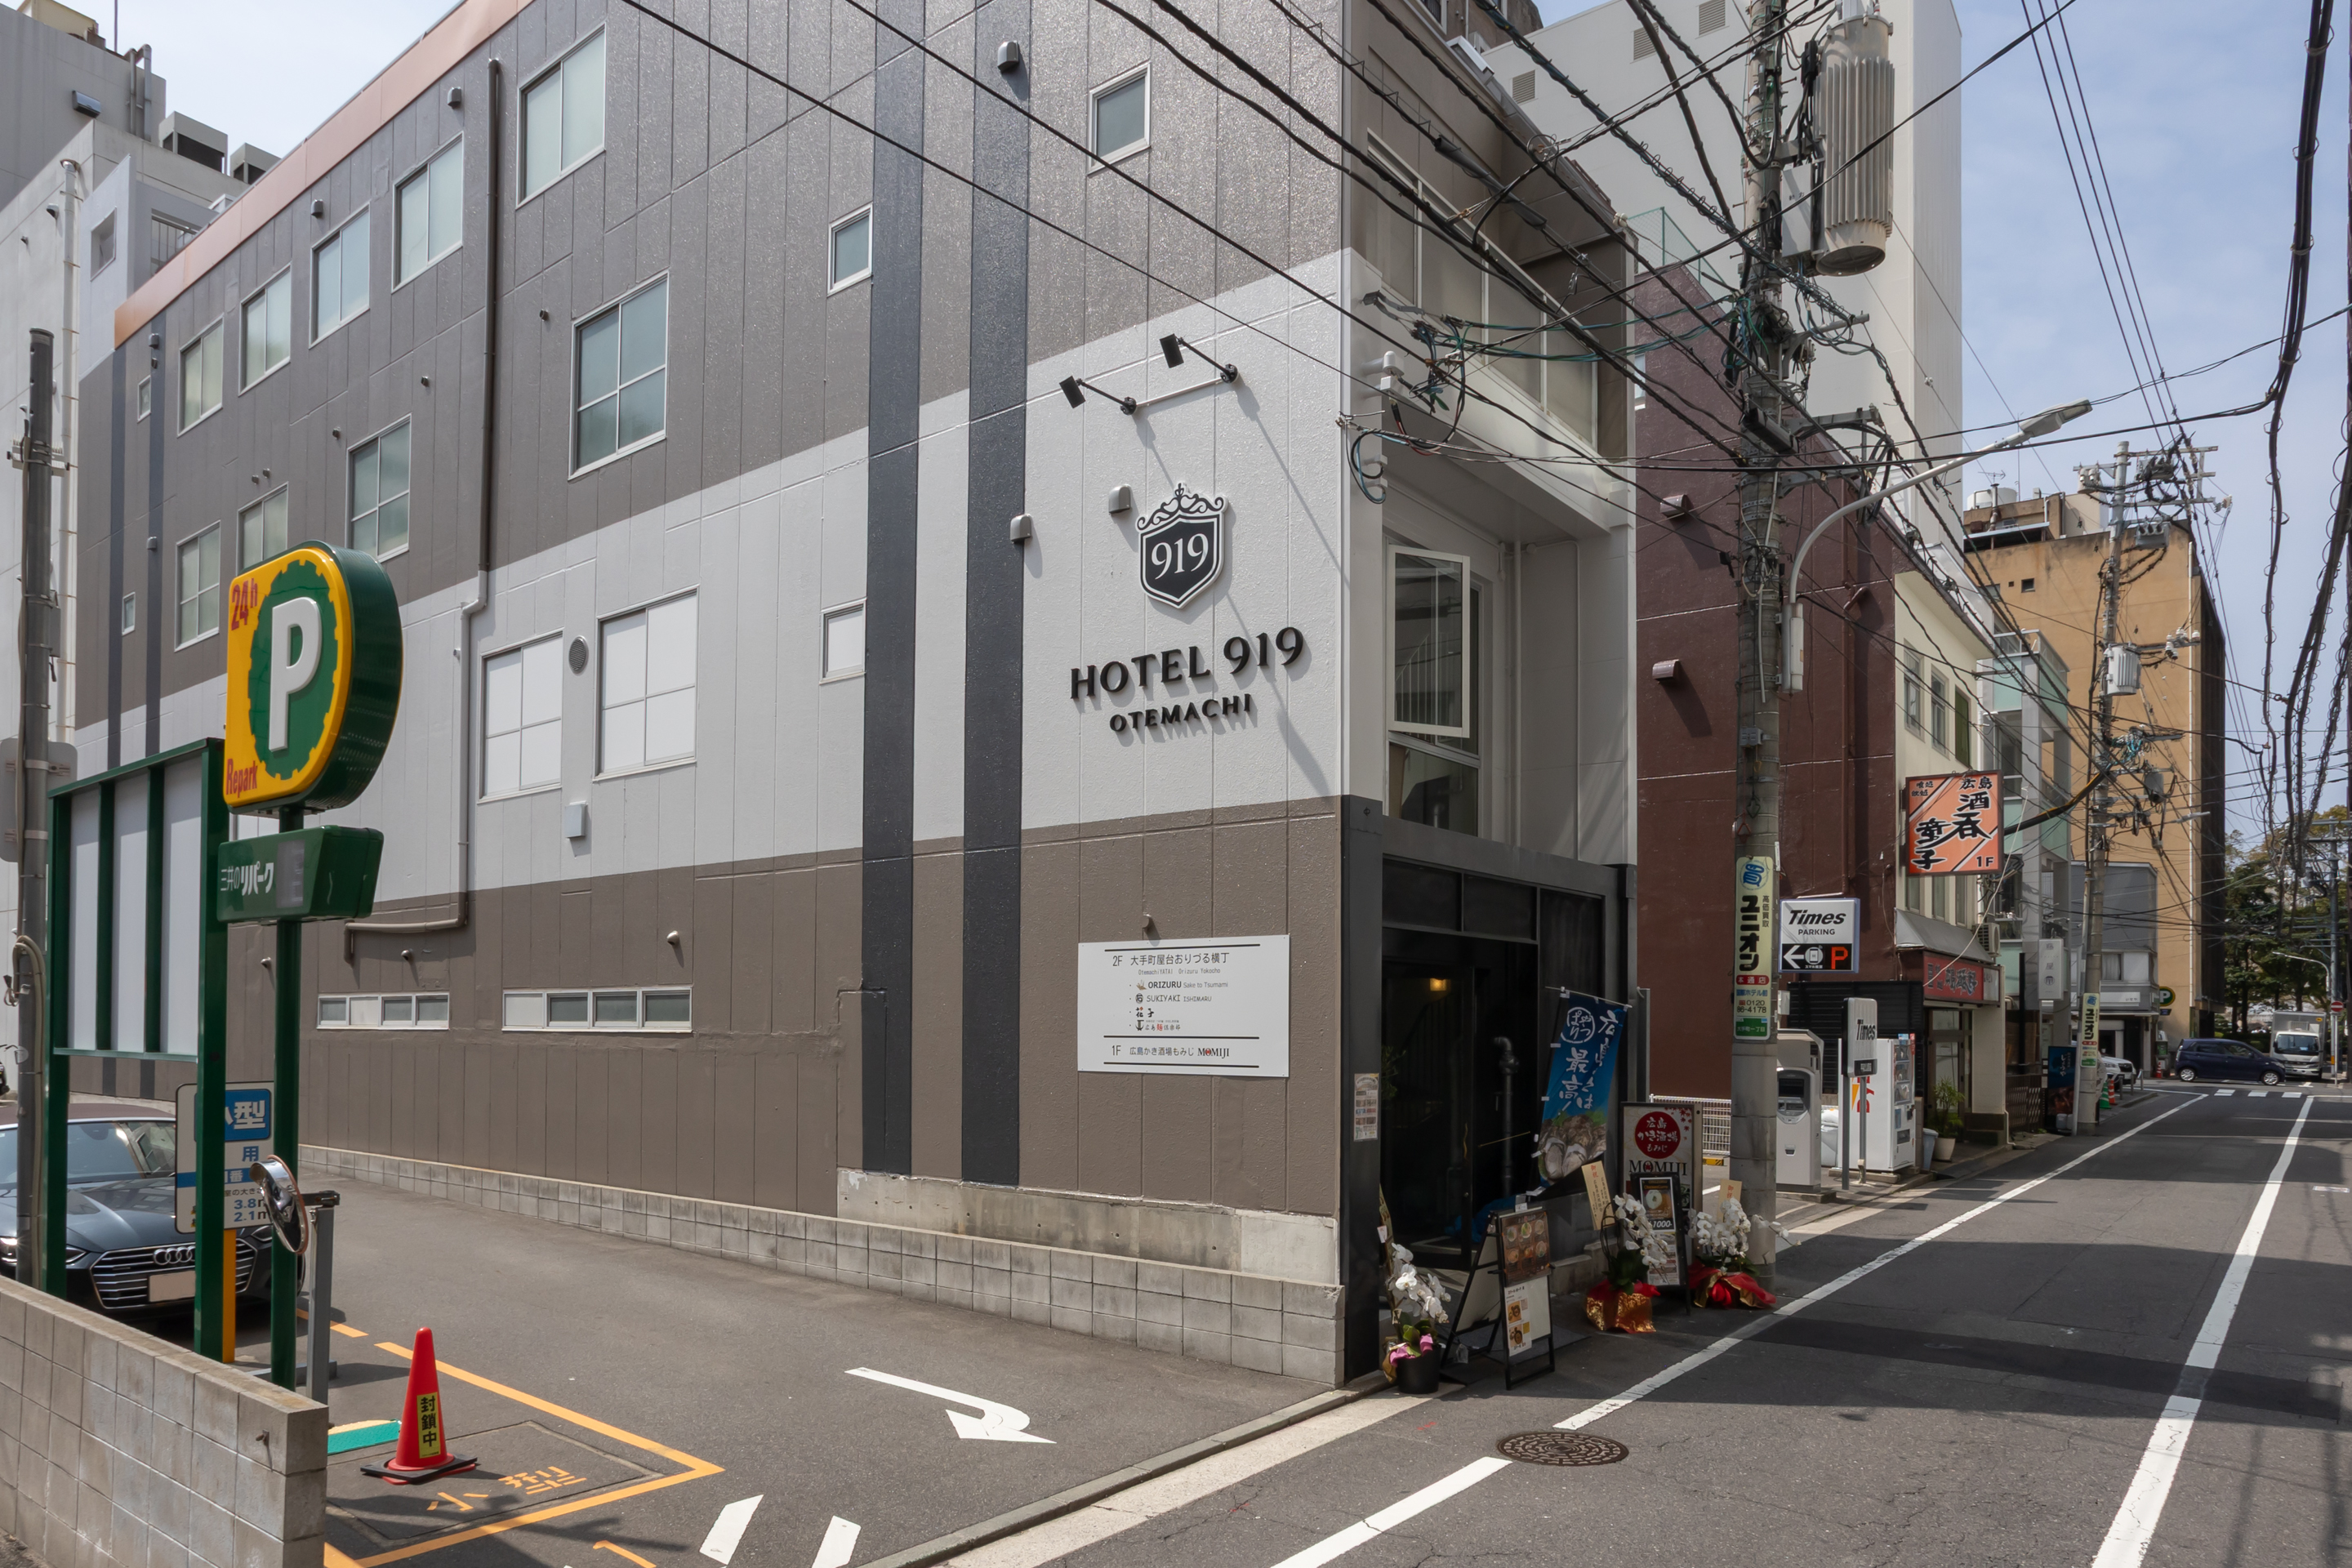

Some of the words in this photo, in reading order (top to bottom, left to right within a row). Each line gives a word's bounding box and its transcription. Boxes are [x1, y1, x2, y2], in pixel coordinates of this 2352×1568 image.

[1151, 532, 1209, 580] 919
[1070, 645, 1211, 700] HOTEL
[1223, 626, 1304, 675] 919
[269, 597, 322, 752] P
[1109, 693, 1251, 733] OTEMACHI
[225, 758, 258, 798] Repark
[1958, 776, 1993, 791] 広島
[1976, 856, 1994, 867] 1F
[220, 861, 274, 896] 三井のリパーク
[1762, 895, 1770, 928] 高価買取
[1788, 909, 1846, 925] Times
[1739, 895, 1761, 972] ユニオン
[1112, 955, 1123, 967] 2F
[1130, 952, 1229, 966] 大手町屋台おりづる横丁
[1831, 947, 1848, 969] P
[1147, 981, 1182, 989] ORIZURU
[1738, 976, 1766, 984] 本通店
[1146, 994, 1181, 1002] SUKIYAKI
[1856, 1019, 1876, 1040] Times
[2084, 1009, 2095, 1040] ユニオン
[1111, 1045, 1121, 1056] 1F
[1129, 1047, 1194, 1056] 広島かき酒場もみじ
[1197, 1048, 1230, 1058] MOMIJI
[225, 1100, 266, 1130] 型
[1646, 1116, 1667, 1129] 広島
[1637, 1129, 1678, 1143] かき酒場
[1646, 1143, 1668, 1153] もみじ
[420, 1395, 437, 1447] 封鎖中
